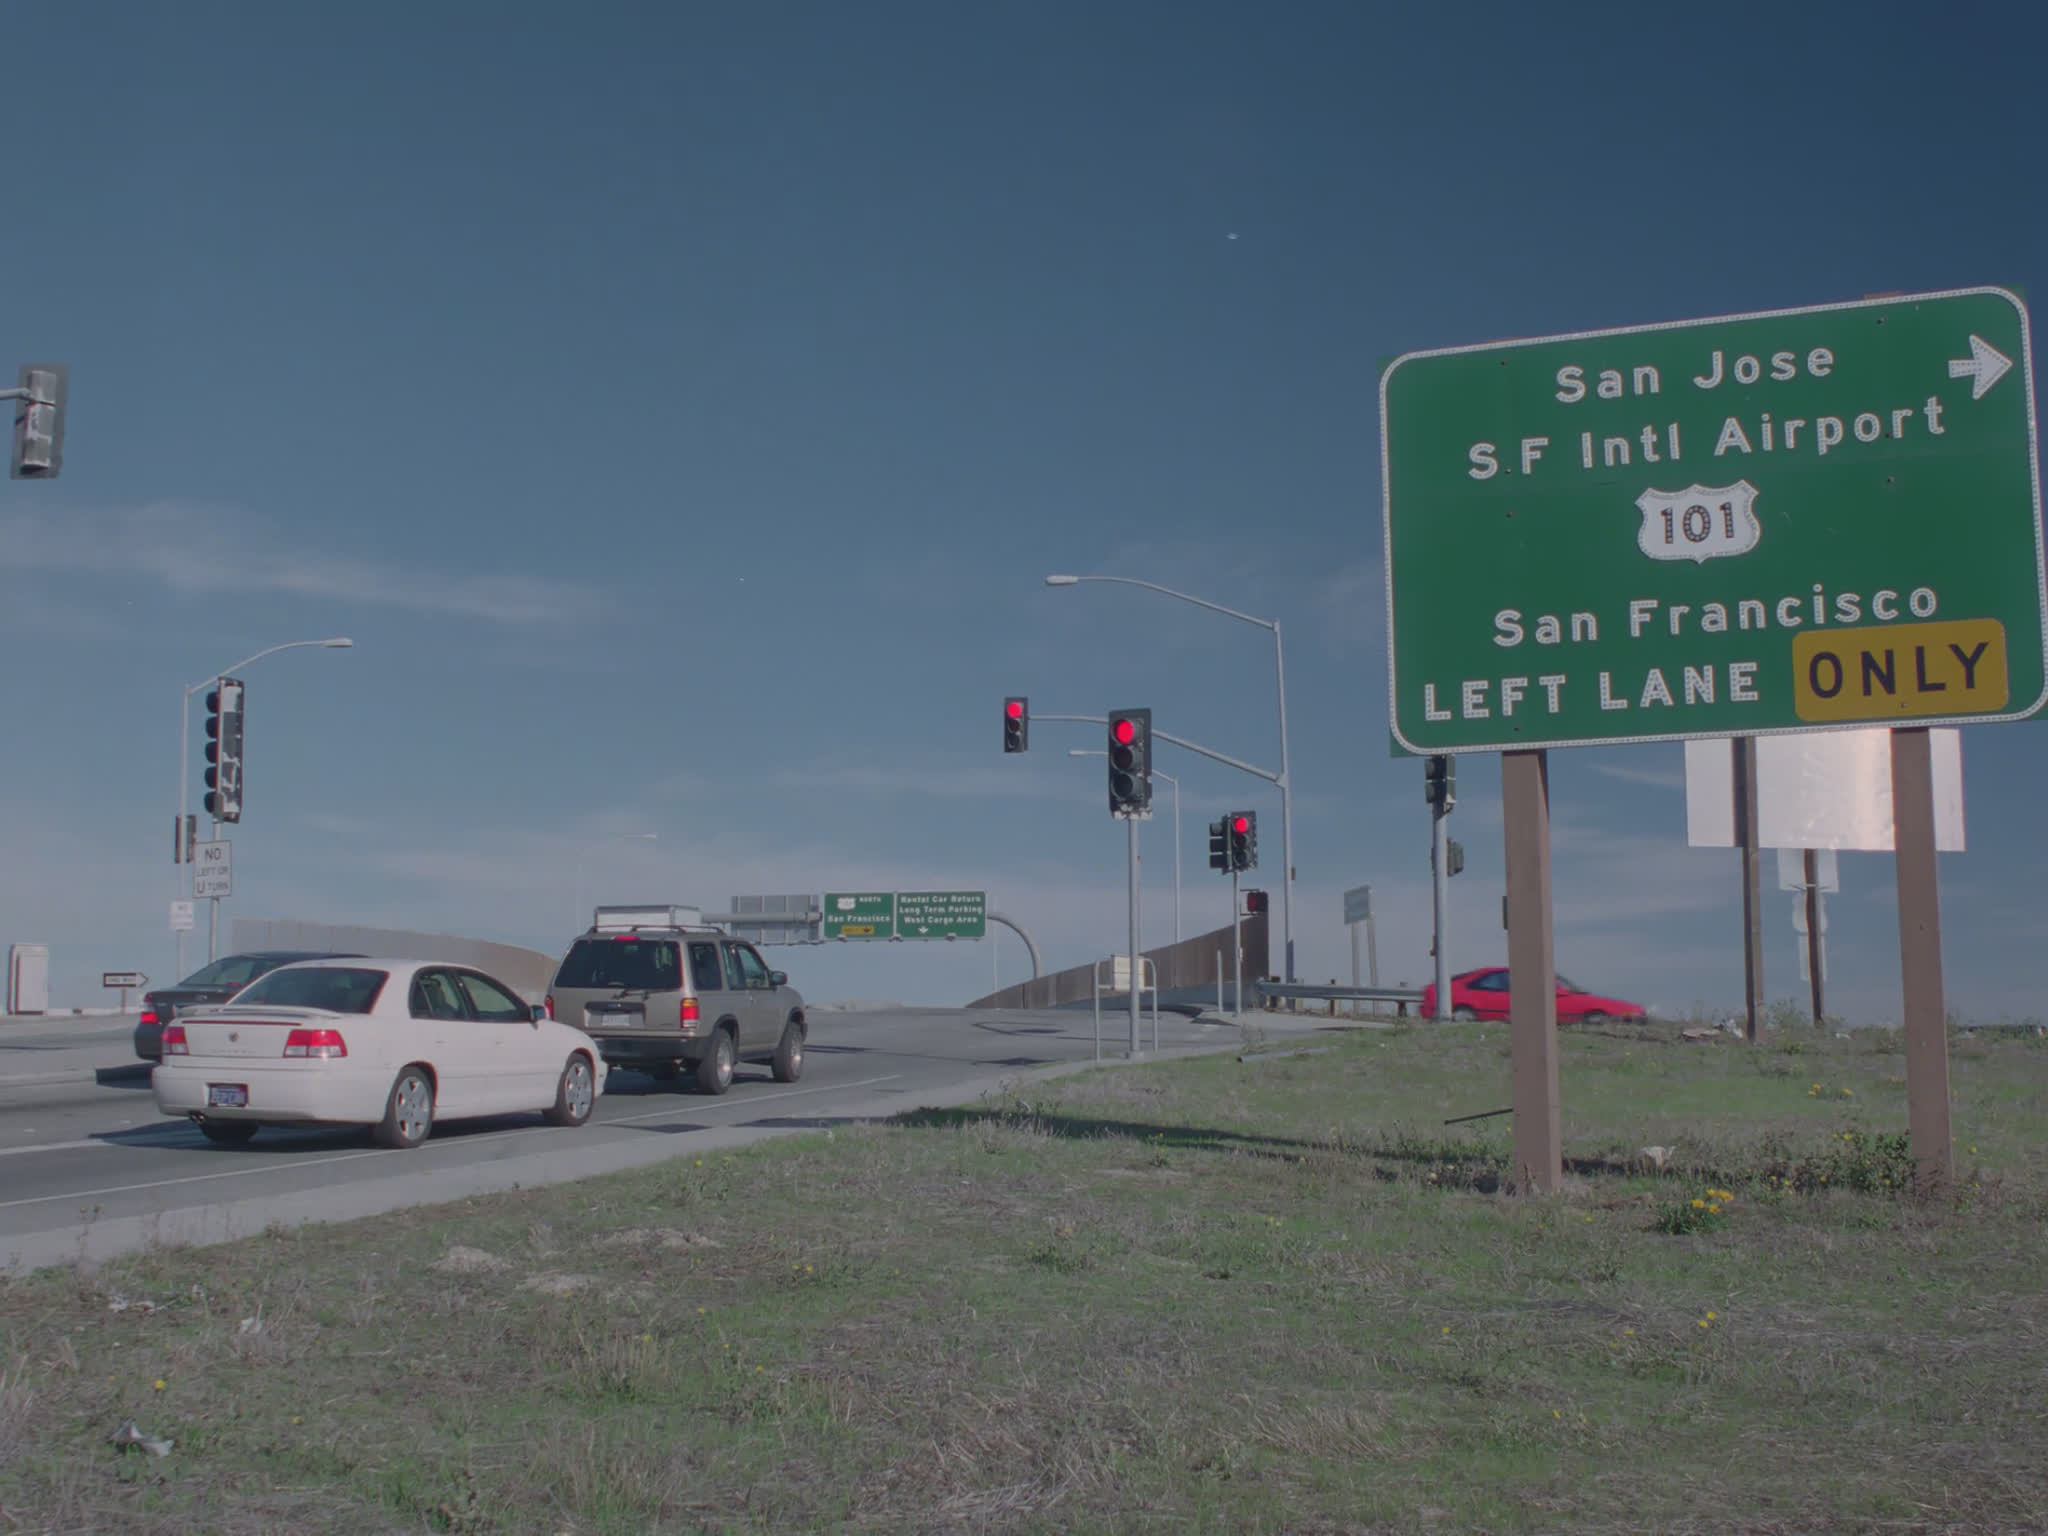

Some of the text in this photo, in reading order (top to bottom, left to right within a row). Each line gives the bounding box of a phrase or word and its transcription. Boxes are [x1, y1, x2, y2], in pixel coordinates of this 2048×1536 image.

[1555, 347, 1835, 403] San Jose
[1468, 396, 1945, 480] S F Intl Airport
[1660, 501, 1736, 546] 101
[1493, 583, 1938, 647] San Francisco
[1424, 641, 1990, 721] LEFT LANE ONLY
[204, 847, 222, 861] NO
[196, 882, 205, 894] U
[931, 895, 947, 903] Car
[950, 895, 981, 903] Return
[899, 905, 983, 915] Long Term Parking
[827, 914, 890, 923] San Francisco
[904, 915, 978, 925] West Cargo Area
